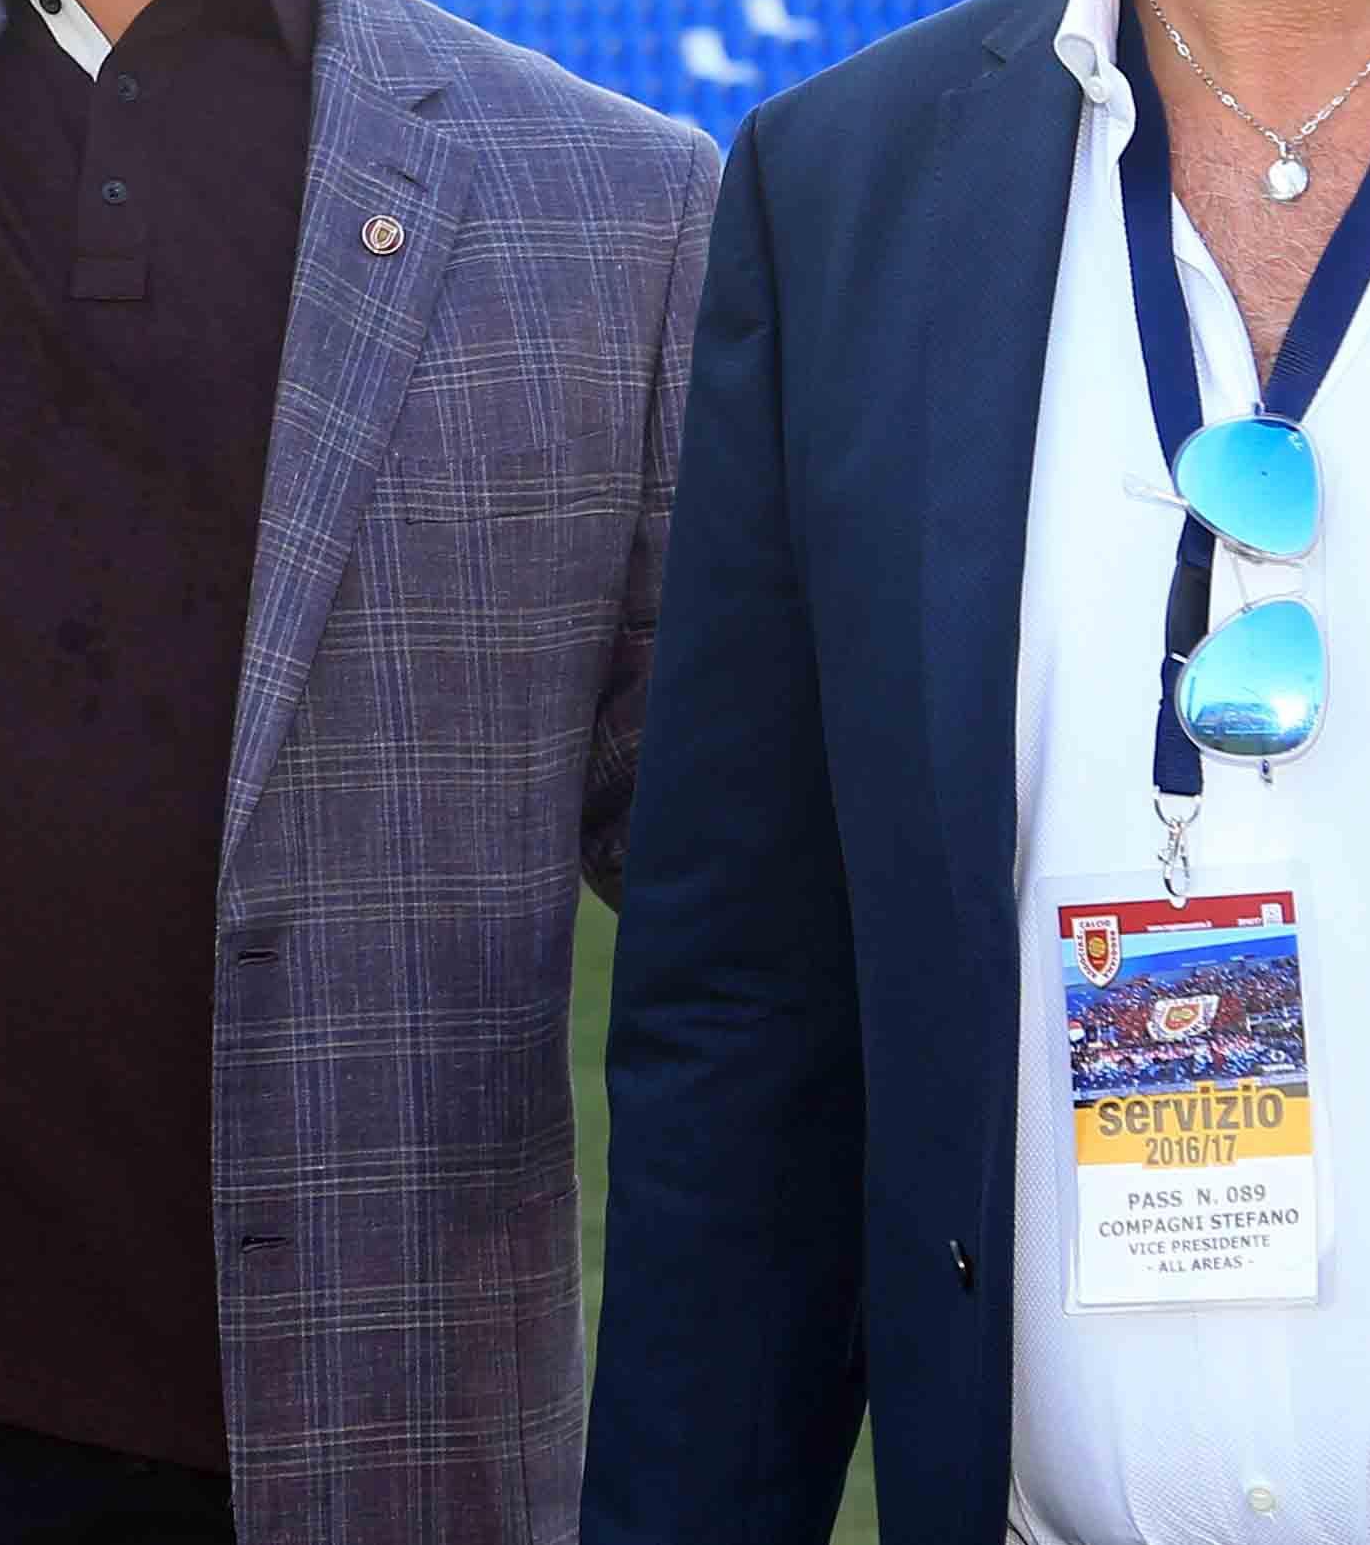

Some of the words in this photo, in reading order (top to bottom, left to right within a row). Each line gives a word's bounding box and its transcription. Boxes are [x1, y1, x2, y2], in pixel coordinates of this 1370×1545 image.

[1098, 1085, 1284, 1137] servizio
[1145, 1134, 1237, 1166] 2016/17
[1128, 1190, 1182, 1210] PASS
[1197, 1187, 1218, 1206] N.
[1226, 1183, 1266, 1204] 089
[1099, 1215, 1204, 1238] COMPAGNI
[1210, 1207, 1300, 1230] STEFANO
[1128, 1241, 1166, 1256] VICE
[1171, 1234, 1271, 1254] PRESIDENTE
[1158, 1259, 1186, 1273] ALL
[1191, 1255, 1243, 1272] AREAS
